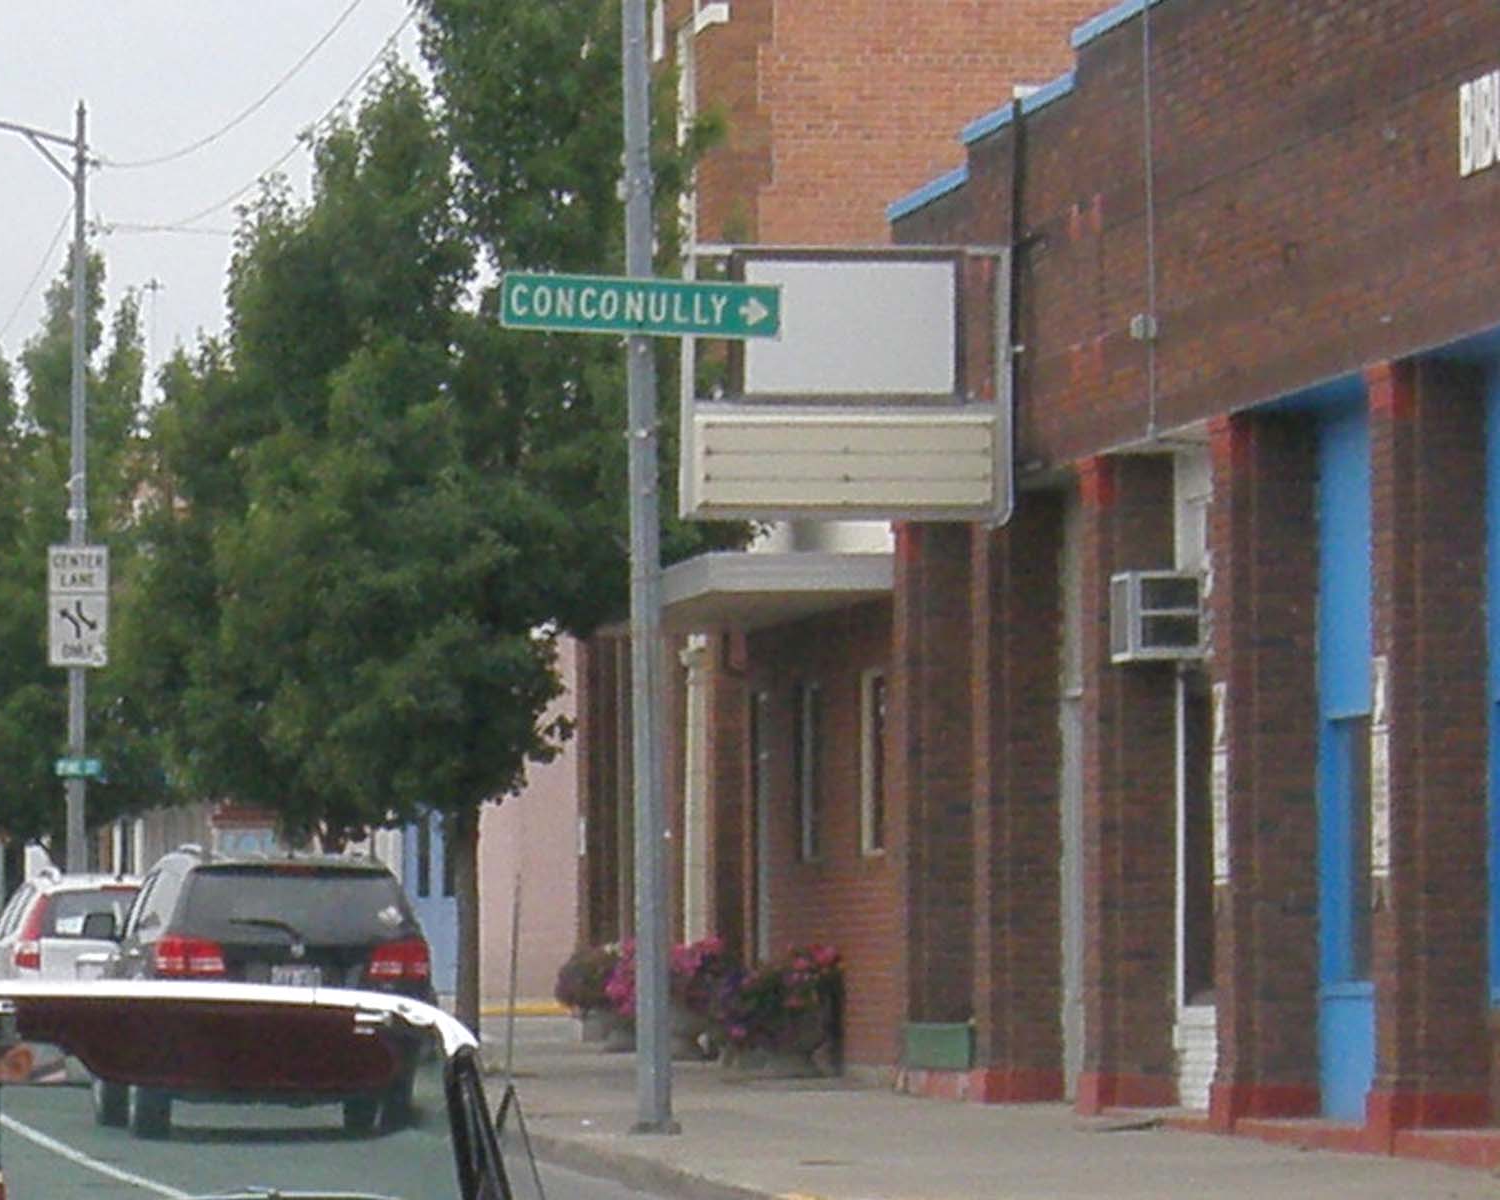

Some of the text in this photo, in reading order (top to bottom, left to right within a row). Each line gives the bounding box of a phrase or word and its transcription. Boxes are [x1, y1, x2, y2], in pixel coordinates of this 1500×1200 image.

[510, 283, 728, 326] CONCONULLY
[52, 553, 103, 569] CENTER
[60, 572, 94, 588] LANE
